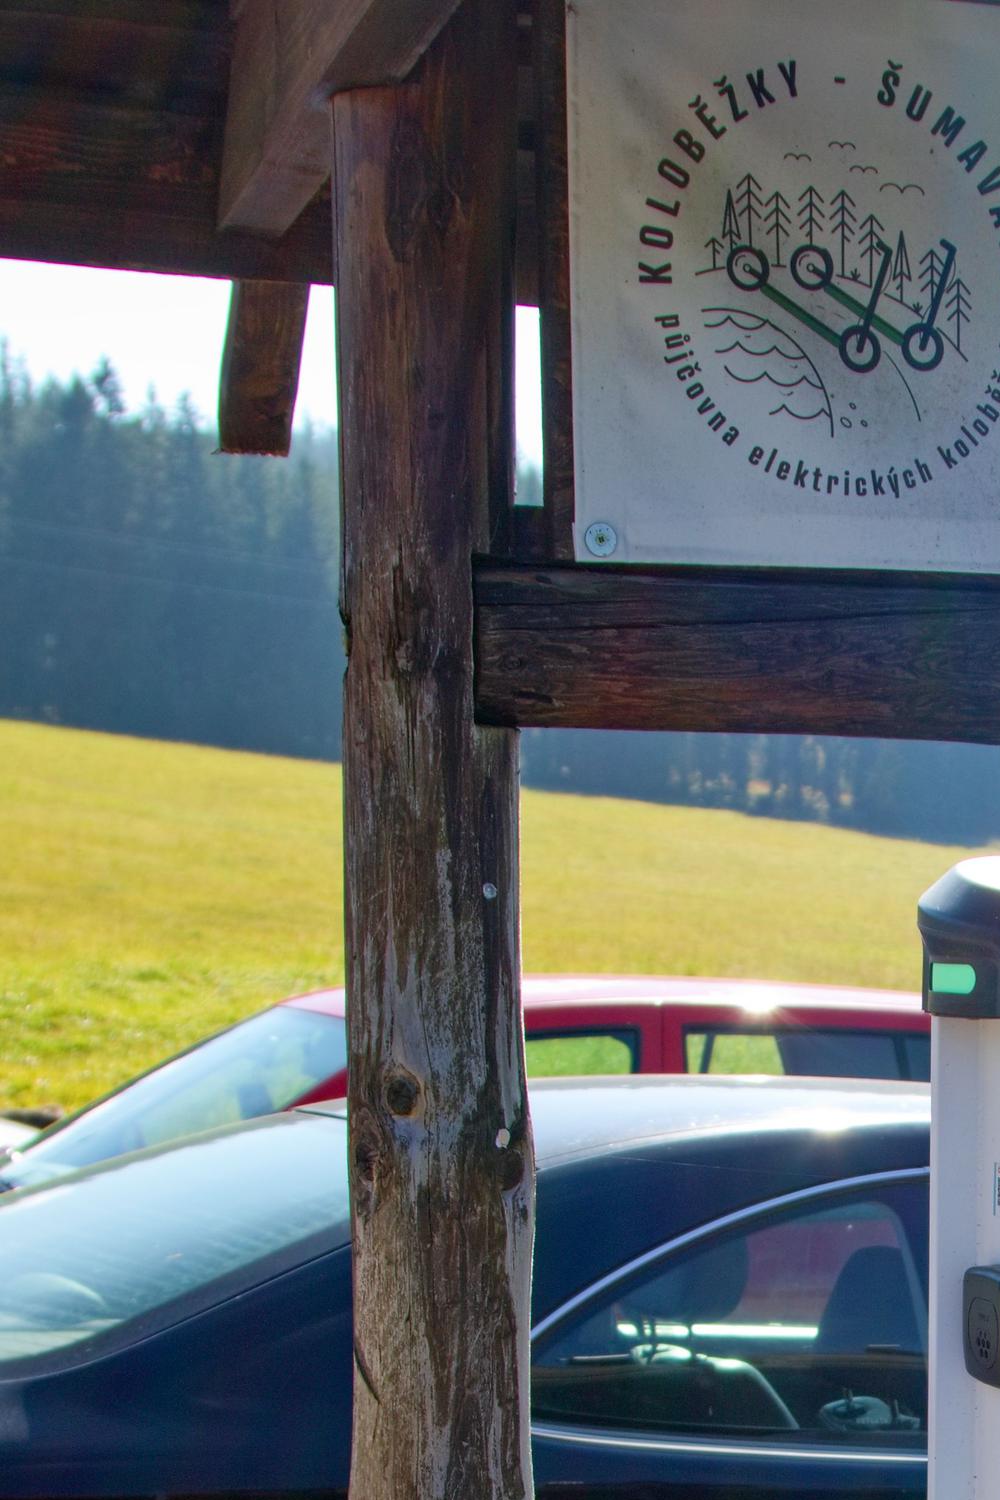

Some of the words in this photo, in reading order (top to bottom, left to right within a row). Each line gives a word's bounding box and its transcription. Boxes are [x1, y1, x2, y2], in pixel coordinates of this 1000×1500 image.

[638, 60, 799, 284] KOLOBĚŽKY
[655, 313, 740, 446] půjčovna
[748, 443, 932, 499] elektrických
